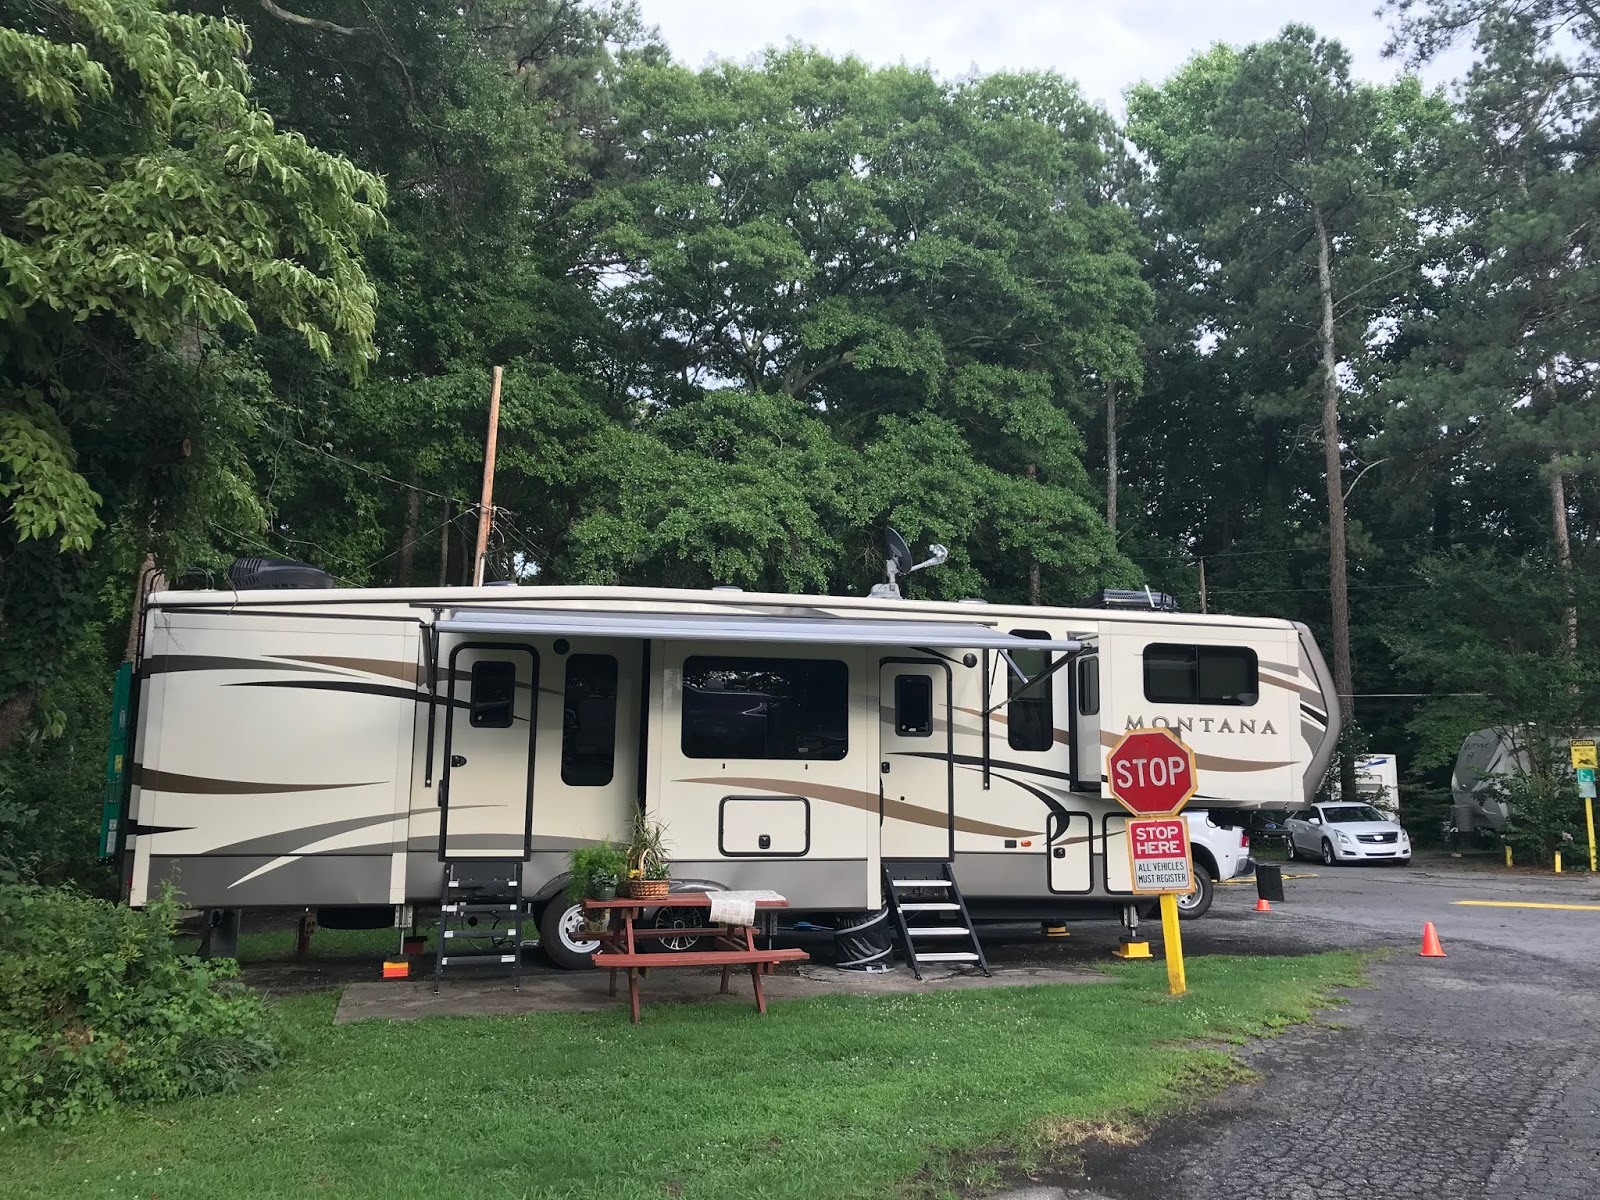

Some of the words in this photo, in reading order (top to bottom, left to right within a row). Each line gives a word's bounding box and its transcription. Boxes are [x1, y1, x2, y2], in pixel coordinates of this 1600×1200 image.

[1125, 715, 1278, 734] MONTANA
[1116, 756, 1185, 789] STOP
[1136, 826, 1179, 840] STOP
[1136, 840, 1181, 854] HERE
[1138, 863, 1151, 872] ALL
[1153, 862, 1185, 871] VEHICLES
[1138, 875, 1155, 883] MUST
[1156, 874, 1186, 883] REGISTER
